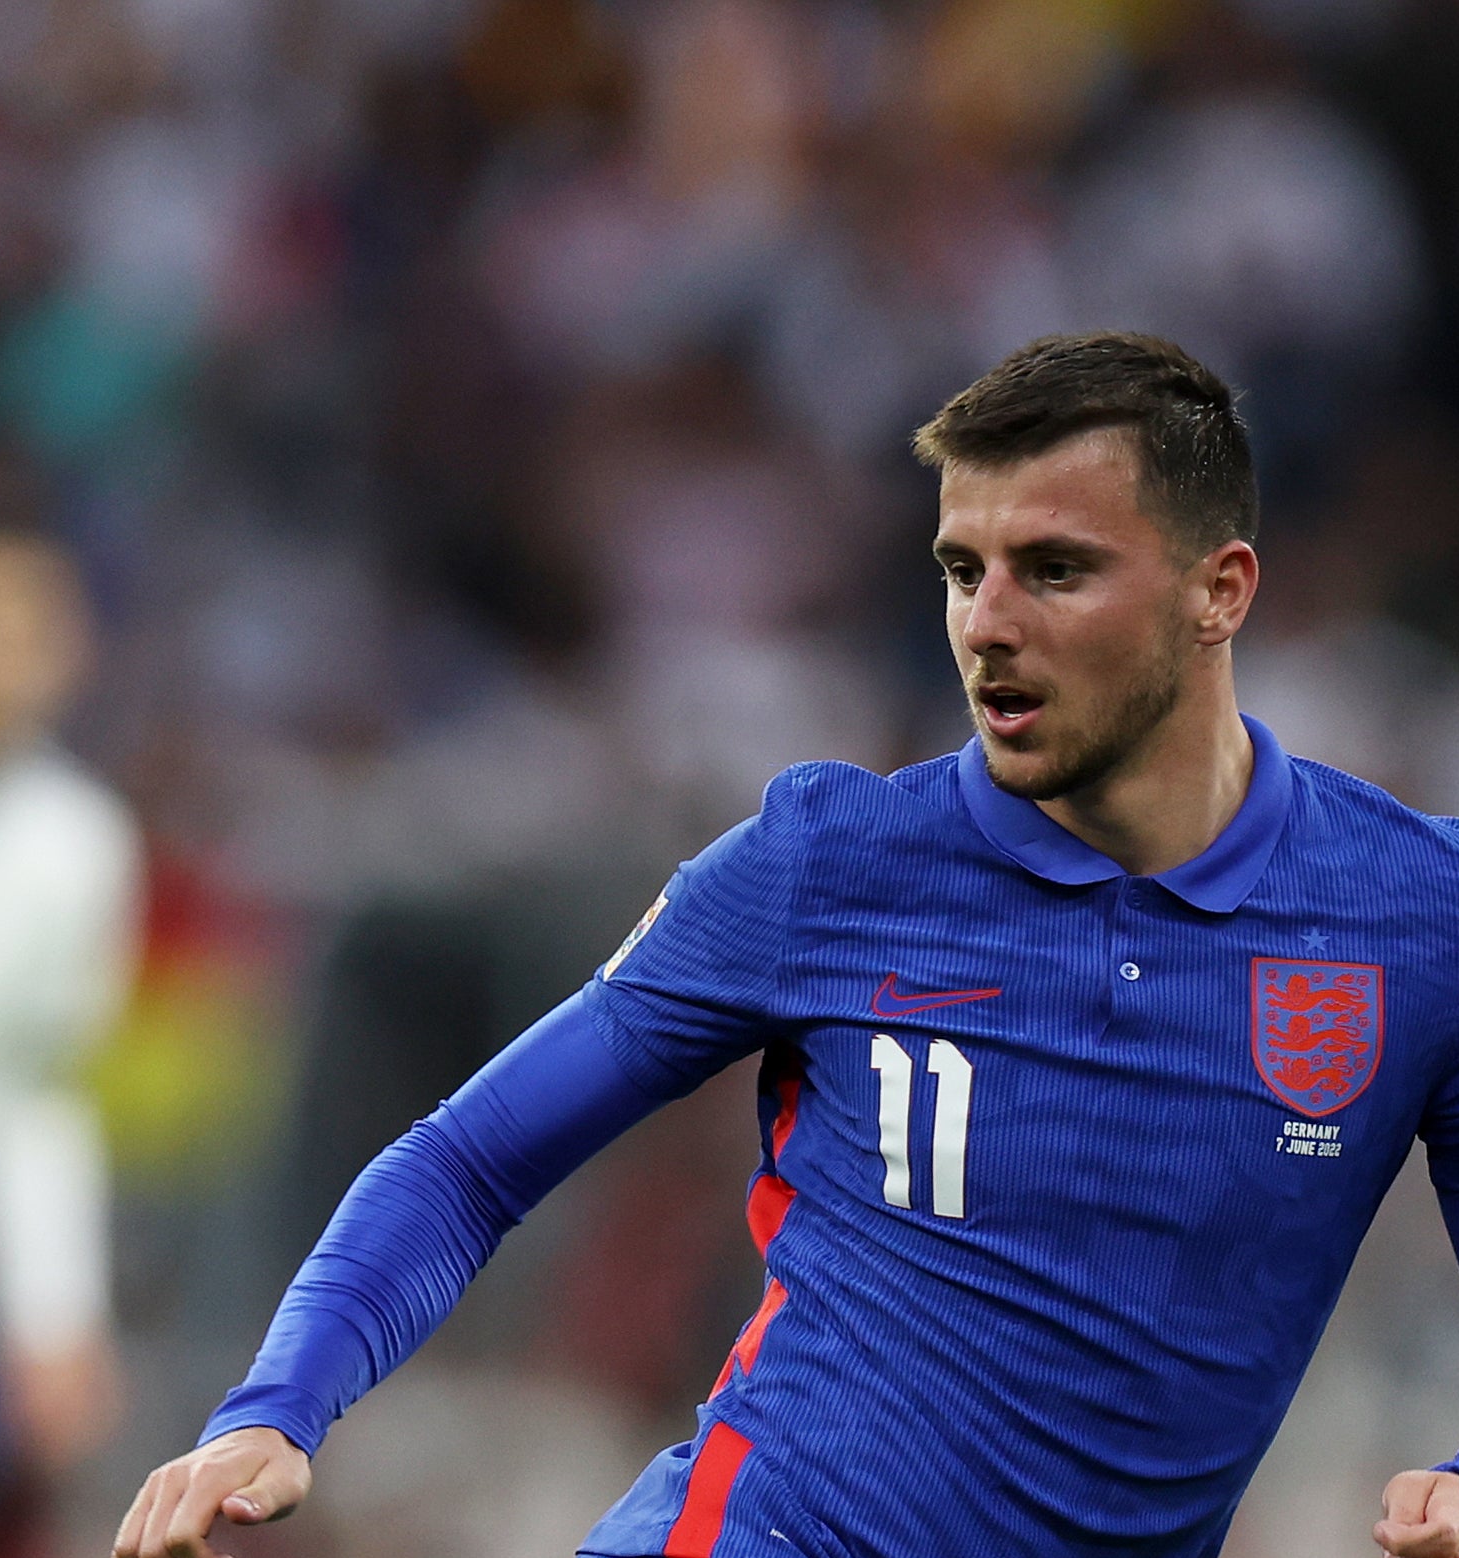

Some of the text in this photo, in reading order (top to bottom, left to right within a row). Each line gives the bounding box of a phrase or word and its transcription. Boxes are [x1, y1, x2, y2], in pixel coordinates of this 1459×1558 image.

[869, 1033, 974, 1219] 11
[1283, 1121, 1340, 1140] GERMANY
[1276, 1136, 1342, 1157] 7 JUNE 2022
